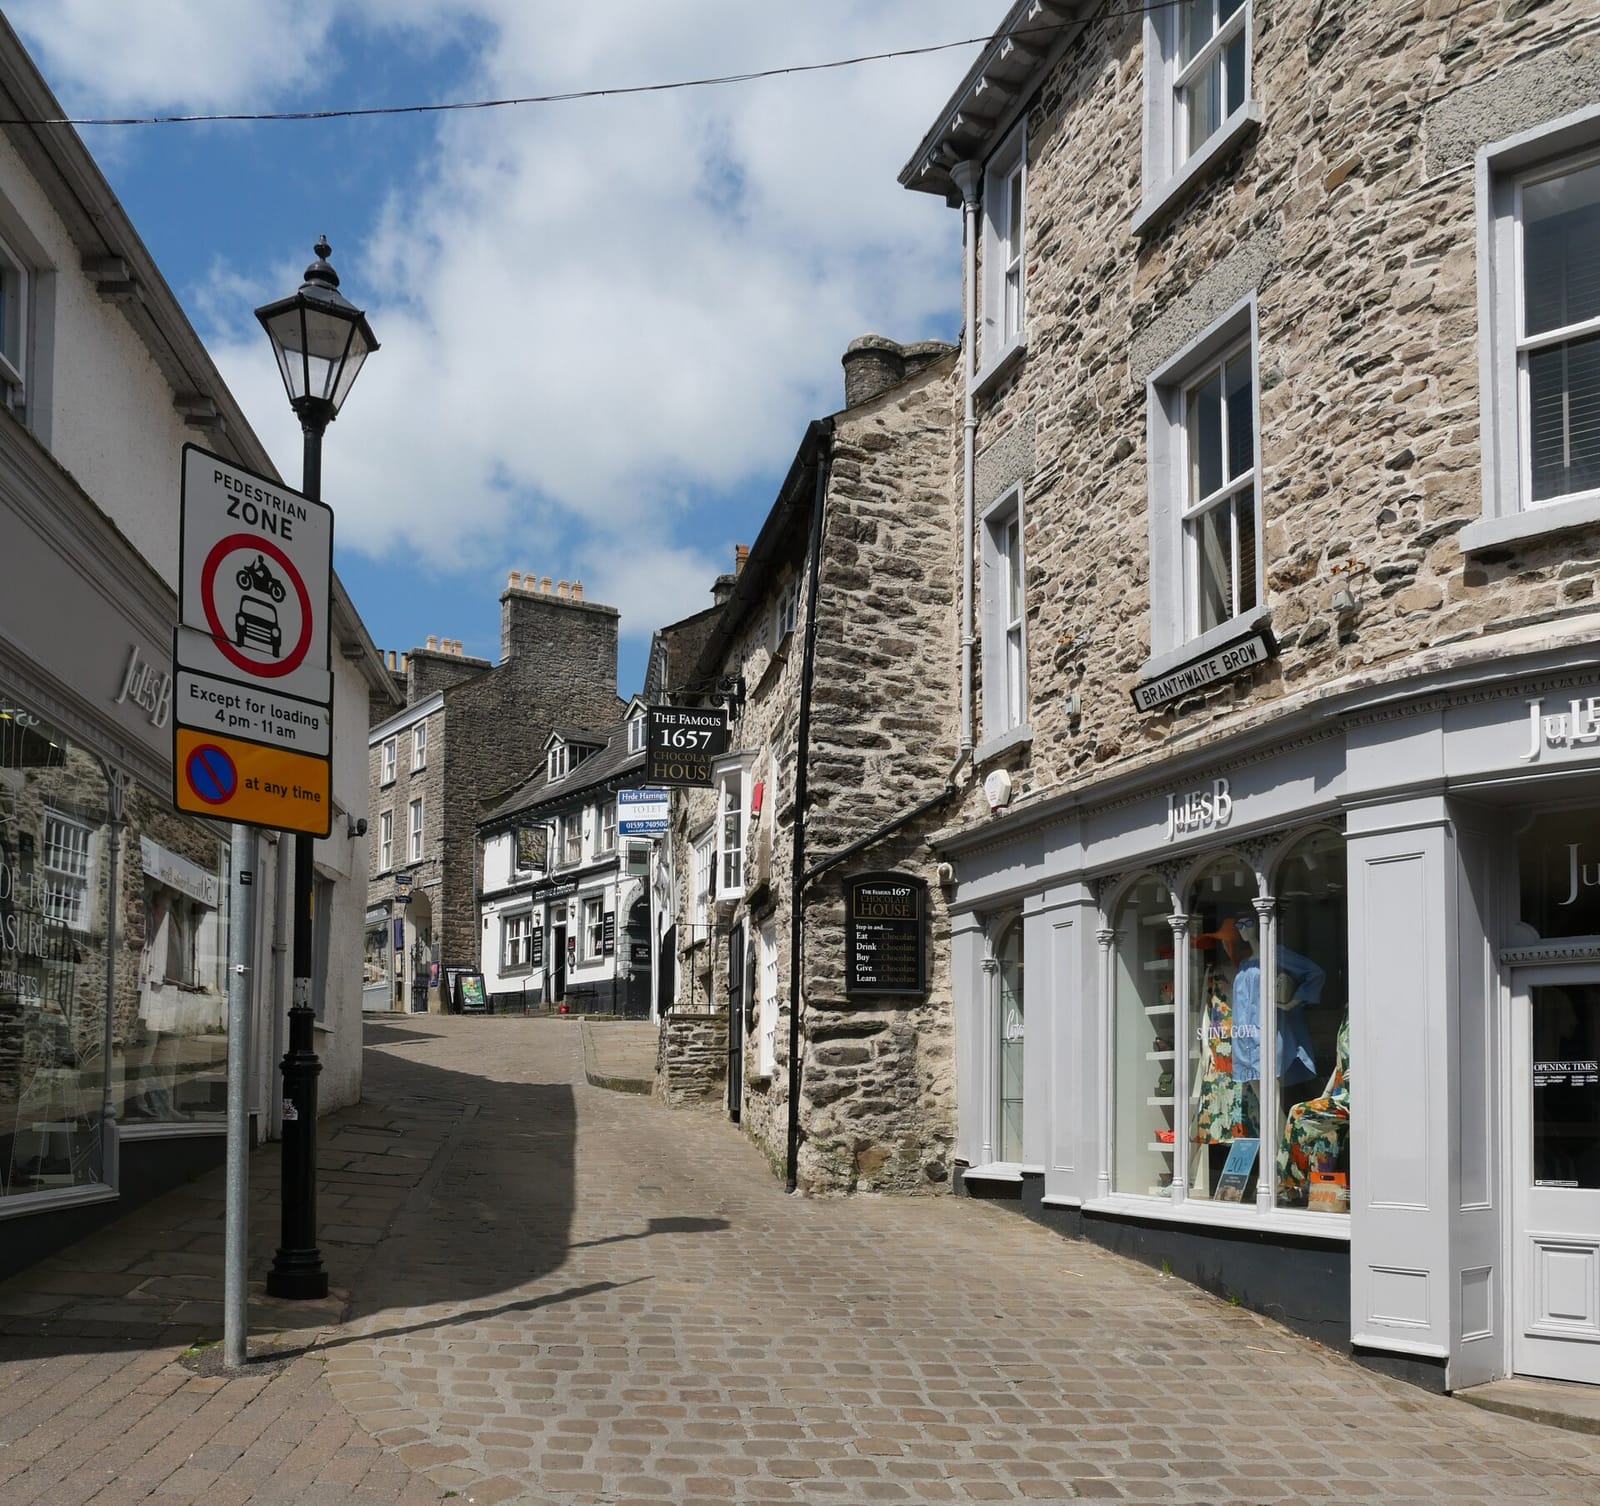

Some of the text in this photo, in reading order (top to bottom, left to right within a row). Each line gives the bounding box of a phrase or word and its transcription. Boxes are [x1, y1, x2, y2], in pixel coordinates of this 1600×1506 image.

[214, 470, 306, 521] PEDESTRIAN
[227, 495, 292, 541] ZONE
[1142, 643, 1257, 705] BRANTHWAITE BROW
[190, 684, 319, 730] Except for loading
[653, 712, 721, 727] THE FAMOUS
[661, 728, 712, 750] 1657
[653, 751, 712, 763] CHOCOLAT
[245, 778, 321, 802] at any time
[892, 888, 911, 896] 1657
[861, 903, 910, 916] HOUSE
[856, 932, 868, 940] Eat
[856, 943, 877, 951] Drink
[856, 953, 870, 963] Buy
[856, 963, 873, 972] Give
[856, 974, 877, 982] Learn
[1534, 1063, 1571, 1071] OPENING
